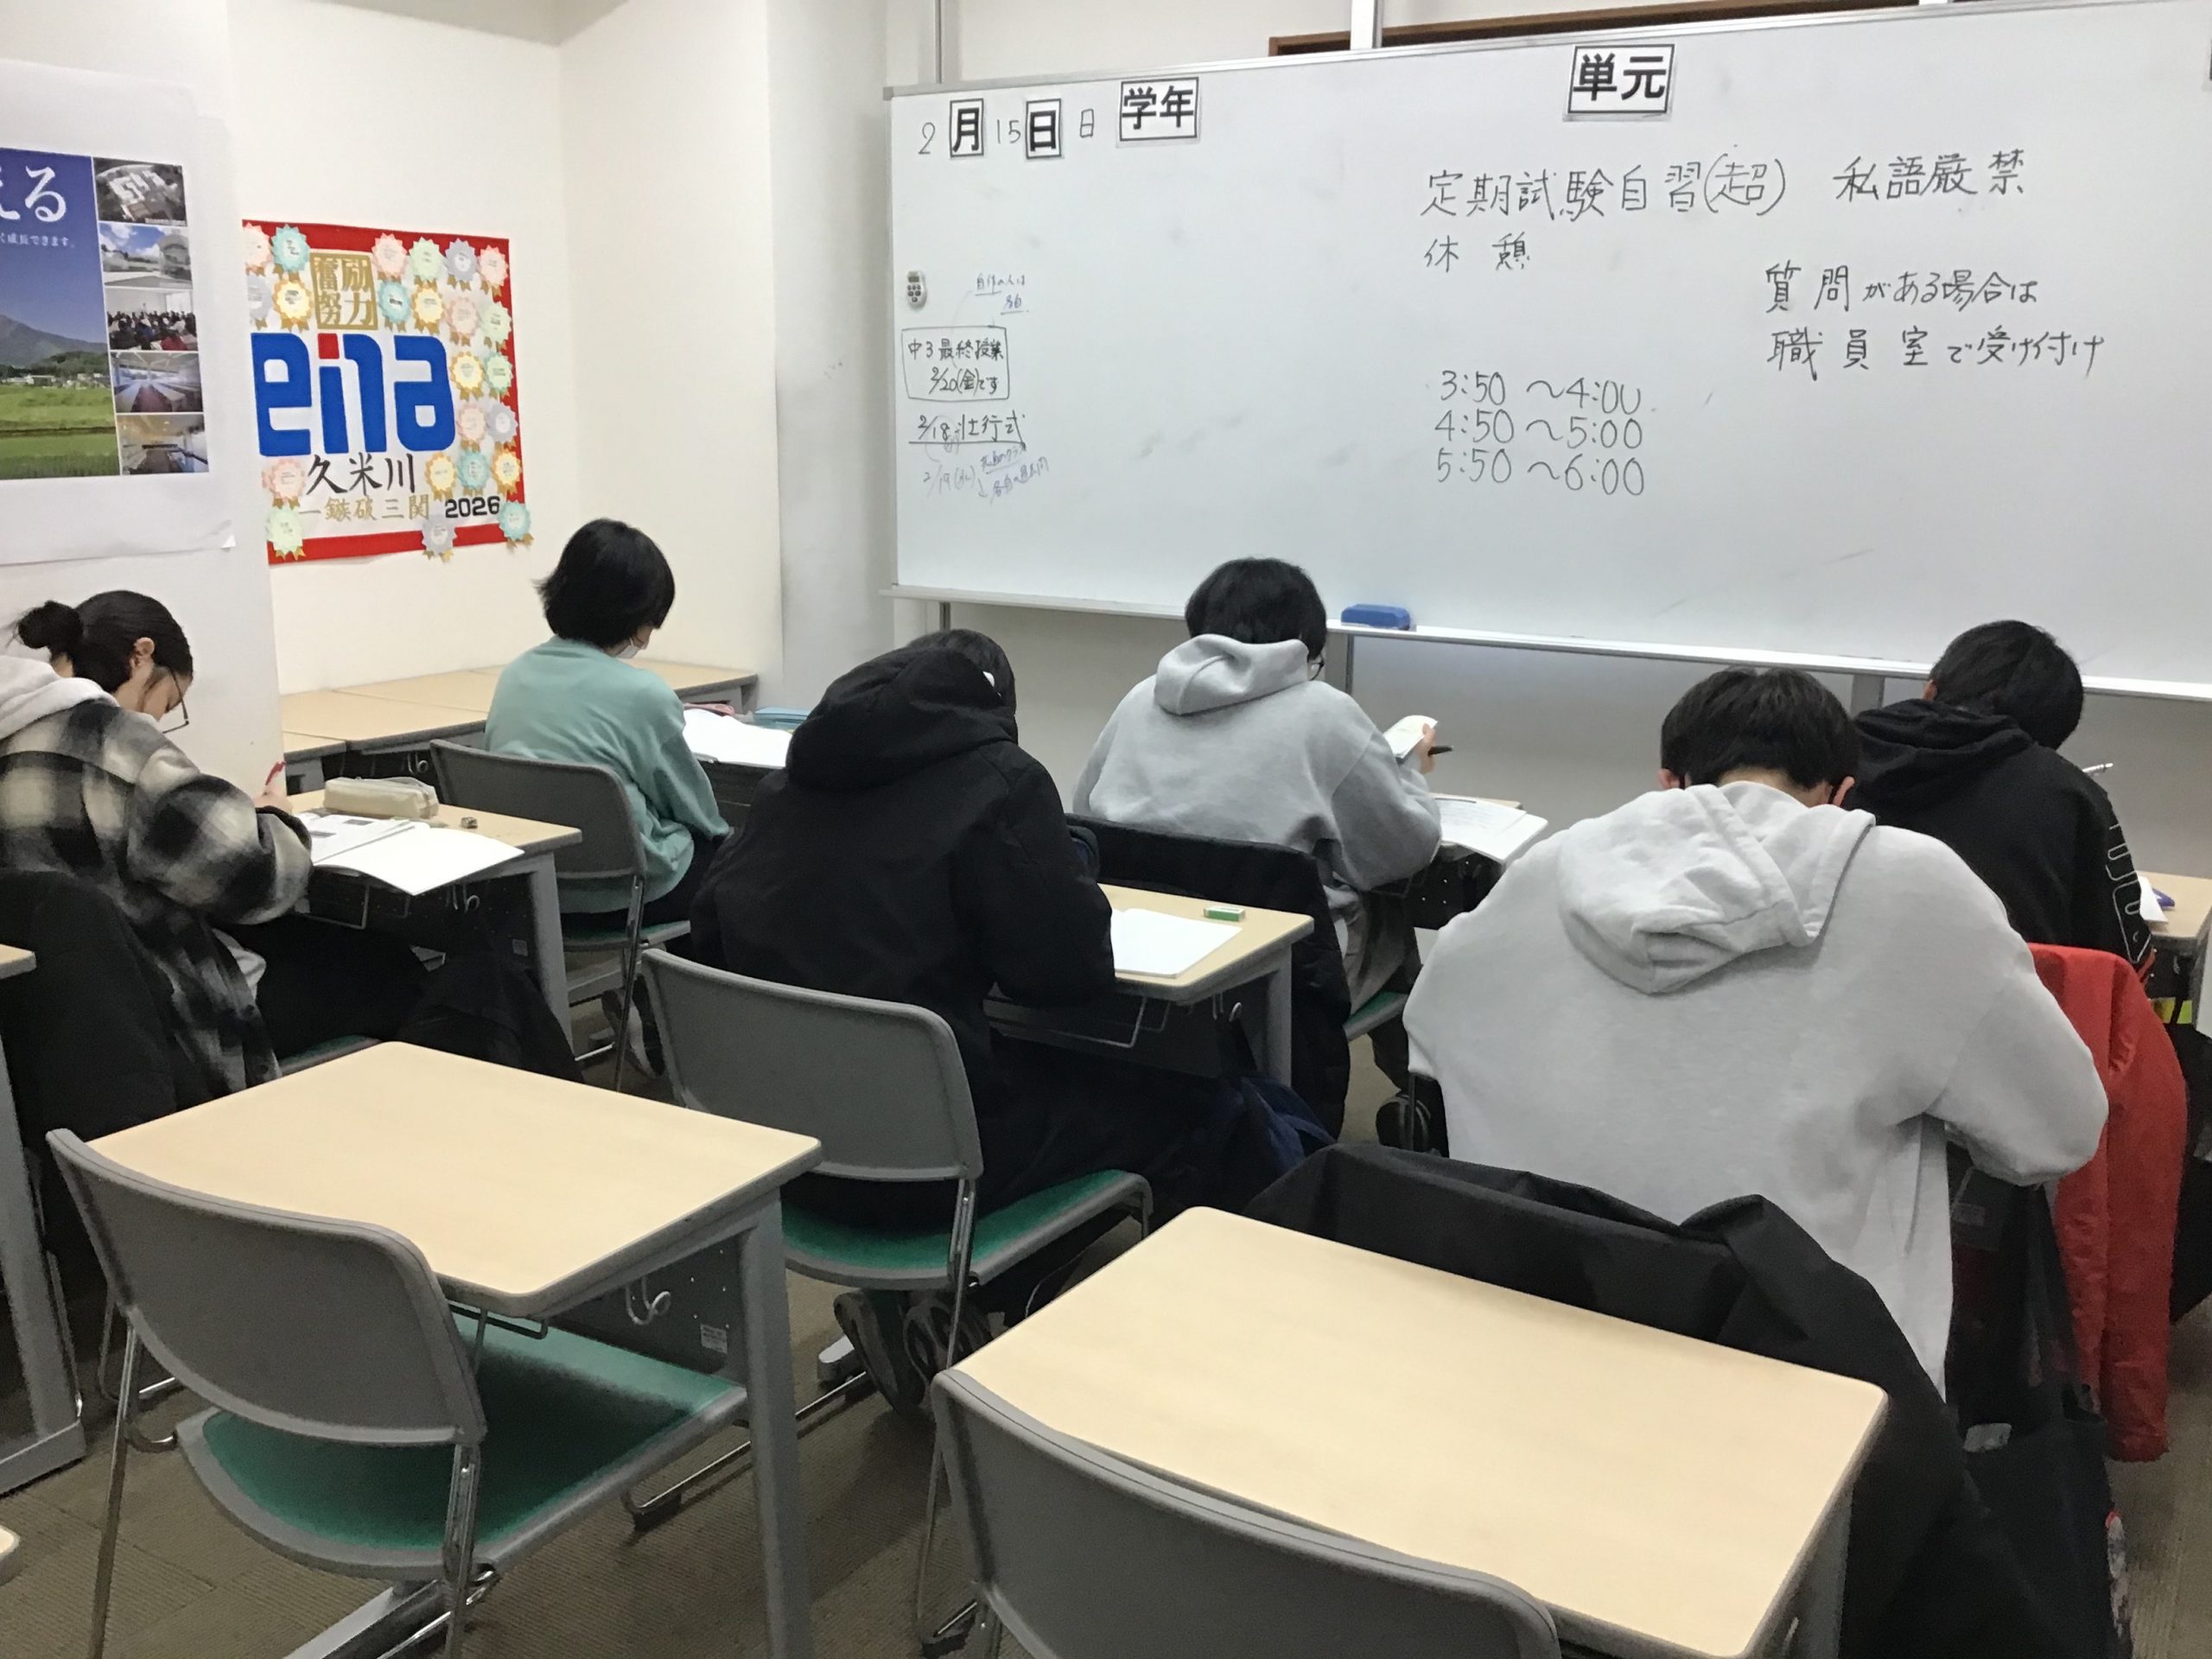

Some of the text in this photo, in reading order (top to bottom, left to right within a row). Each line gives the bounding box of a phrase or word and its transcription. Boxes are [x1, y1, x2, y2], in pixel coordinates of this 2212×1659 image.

[1573, 52, 1667, 101] 単元
[1122, 85, 1194, 130] 学年
[0, 165, 67, 222] る
[1421, 149, 2025, 223] 定期試験自習(超) 私語厳禁
[1765, 259, 2038, 313] 質問がある場合は
[1767, 325, 2105, 381] 職員室で受け付け
[307, 451, 416, 496] 久米川
[445, 496, 500, 518] 2026
